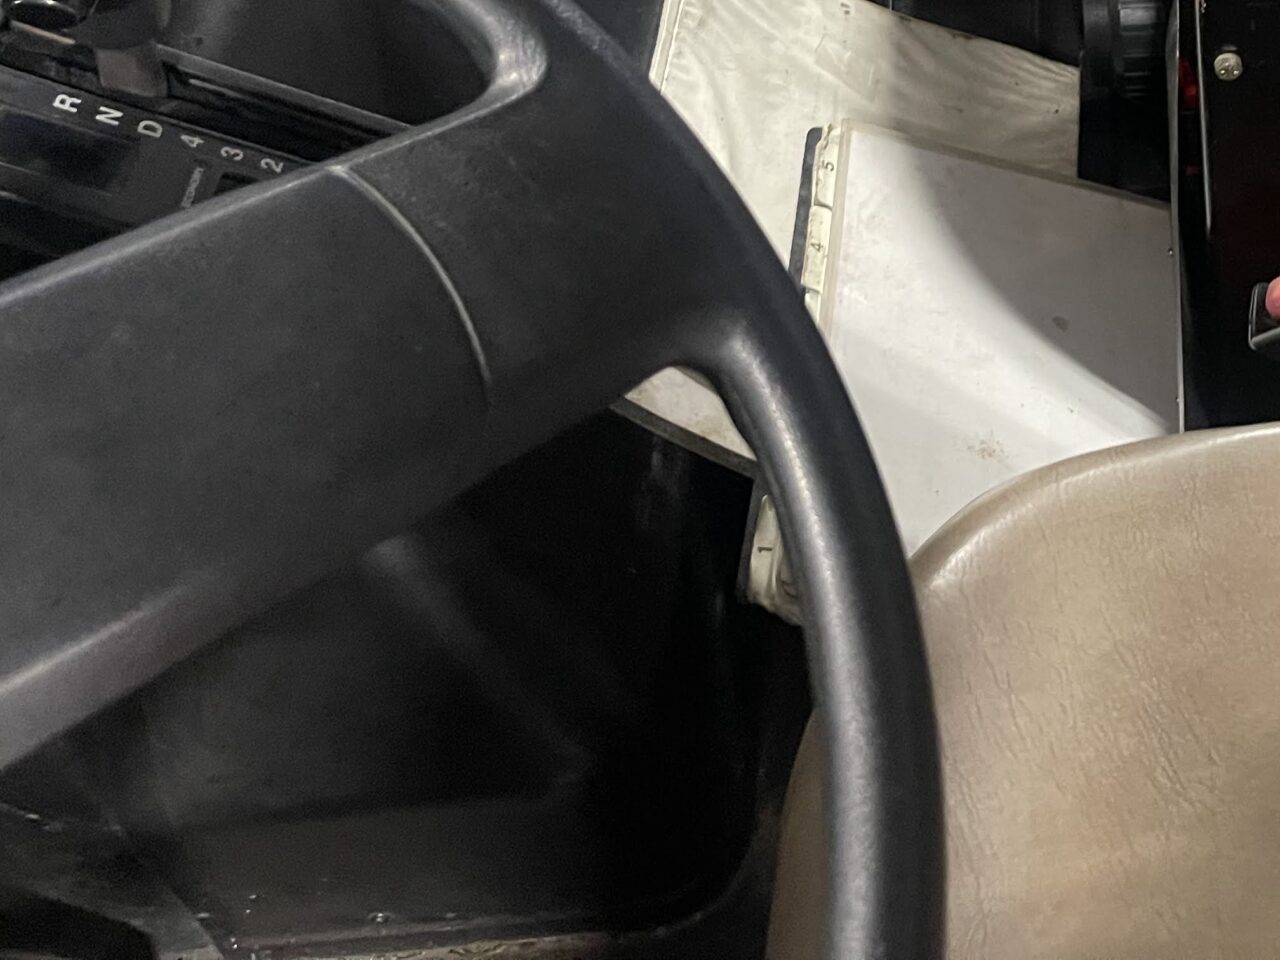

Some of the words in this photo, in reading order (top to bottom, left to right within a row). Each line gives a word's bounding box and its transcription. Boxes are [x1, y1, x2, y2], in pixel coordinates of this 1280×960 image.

[52, 93, 82, 113] R
[95, 106, 124, 126] N
[137, 119, 163, 138] D
[180, 133, 204, 148] 4
[220, 145, 244, 161] 3
[260, 157, 284, 174] 2
[821, 159, 834, 172] 5
[810, 241, 824, 253] 4
